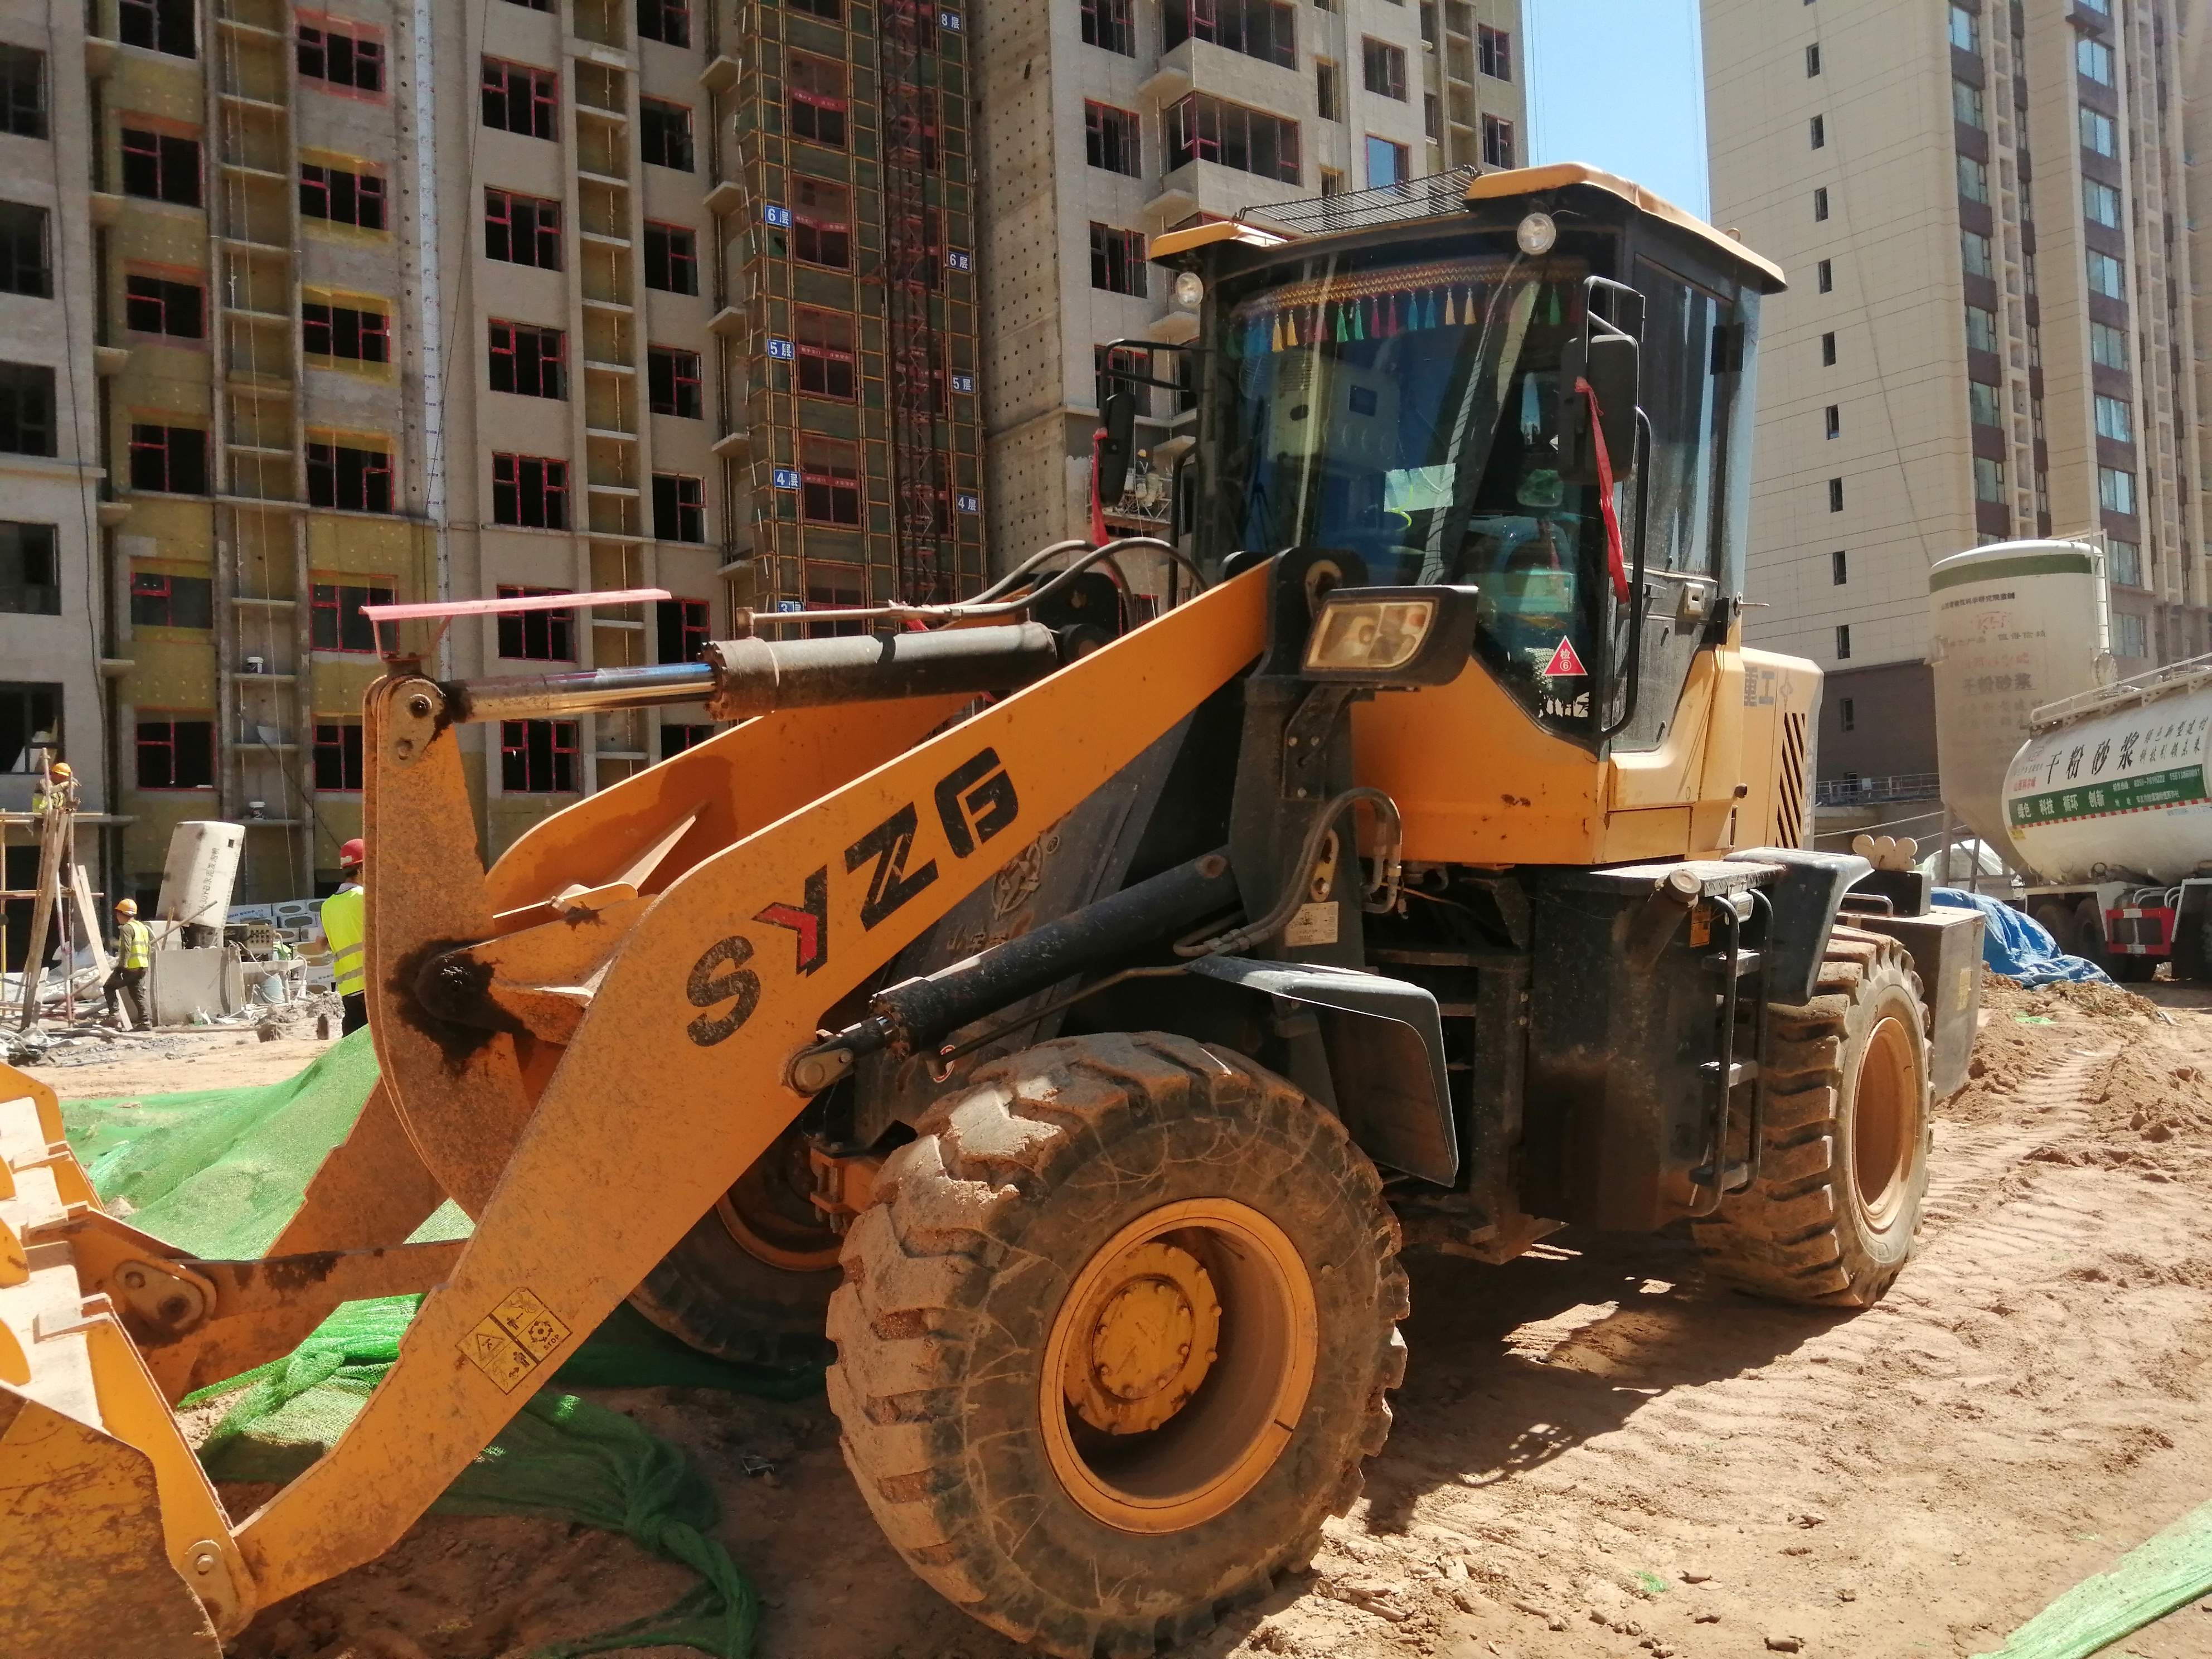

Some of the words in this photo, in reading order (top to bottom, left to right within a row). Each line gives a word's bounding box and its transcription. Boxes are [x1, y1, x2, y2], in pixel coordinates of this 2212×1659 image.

[768, 208, 789, 225] 6层
[950, 254, 968, 269] 6层
[770, 342, 791, 357] 5层
[953, 377, 971, 390] 5层
[777, 472, 798, 487] 4层
[958, 497, 976, 511] 4层
[2046, 731, 2140, 784] 干粉砂浆
[2017, 802, 2031, 819] 绿色
[2039, 798, 2055, 816] 科技
[2063, 794, 2078, 812] 循环
[2088, 789, 2105, 808] 创新
[687, 747, 1019, 1047] SYZG
[544, 1334, 559, 1350] STOP
